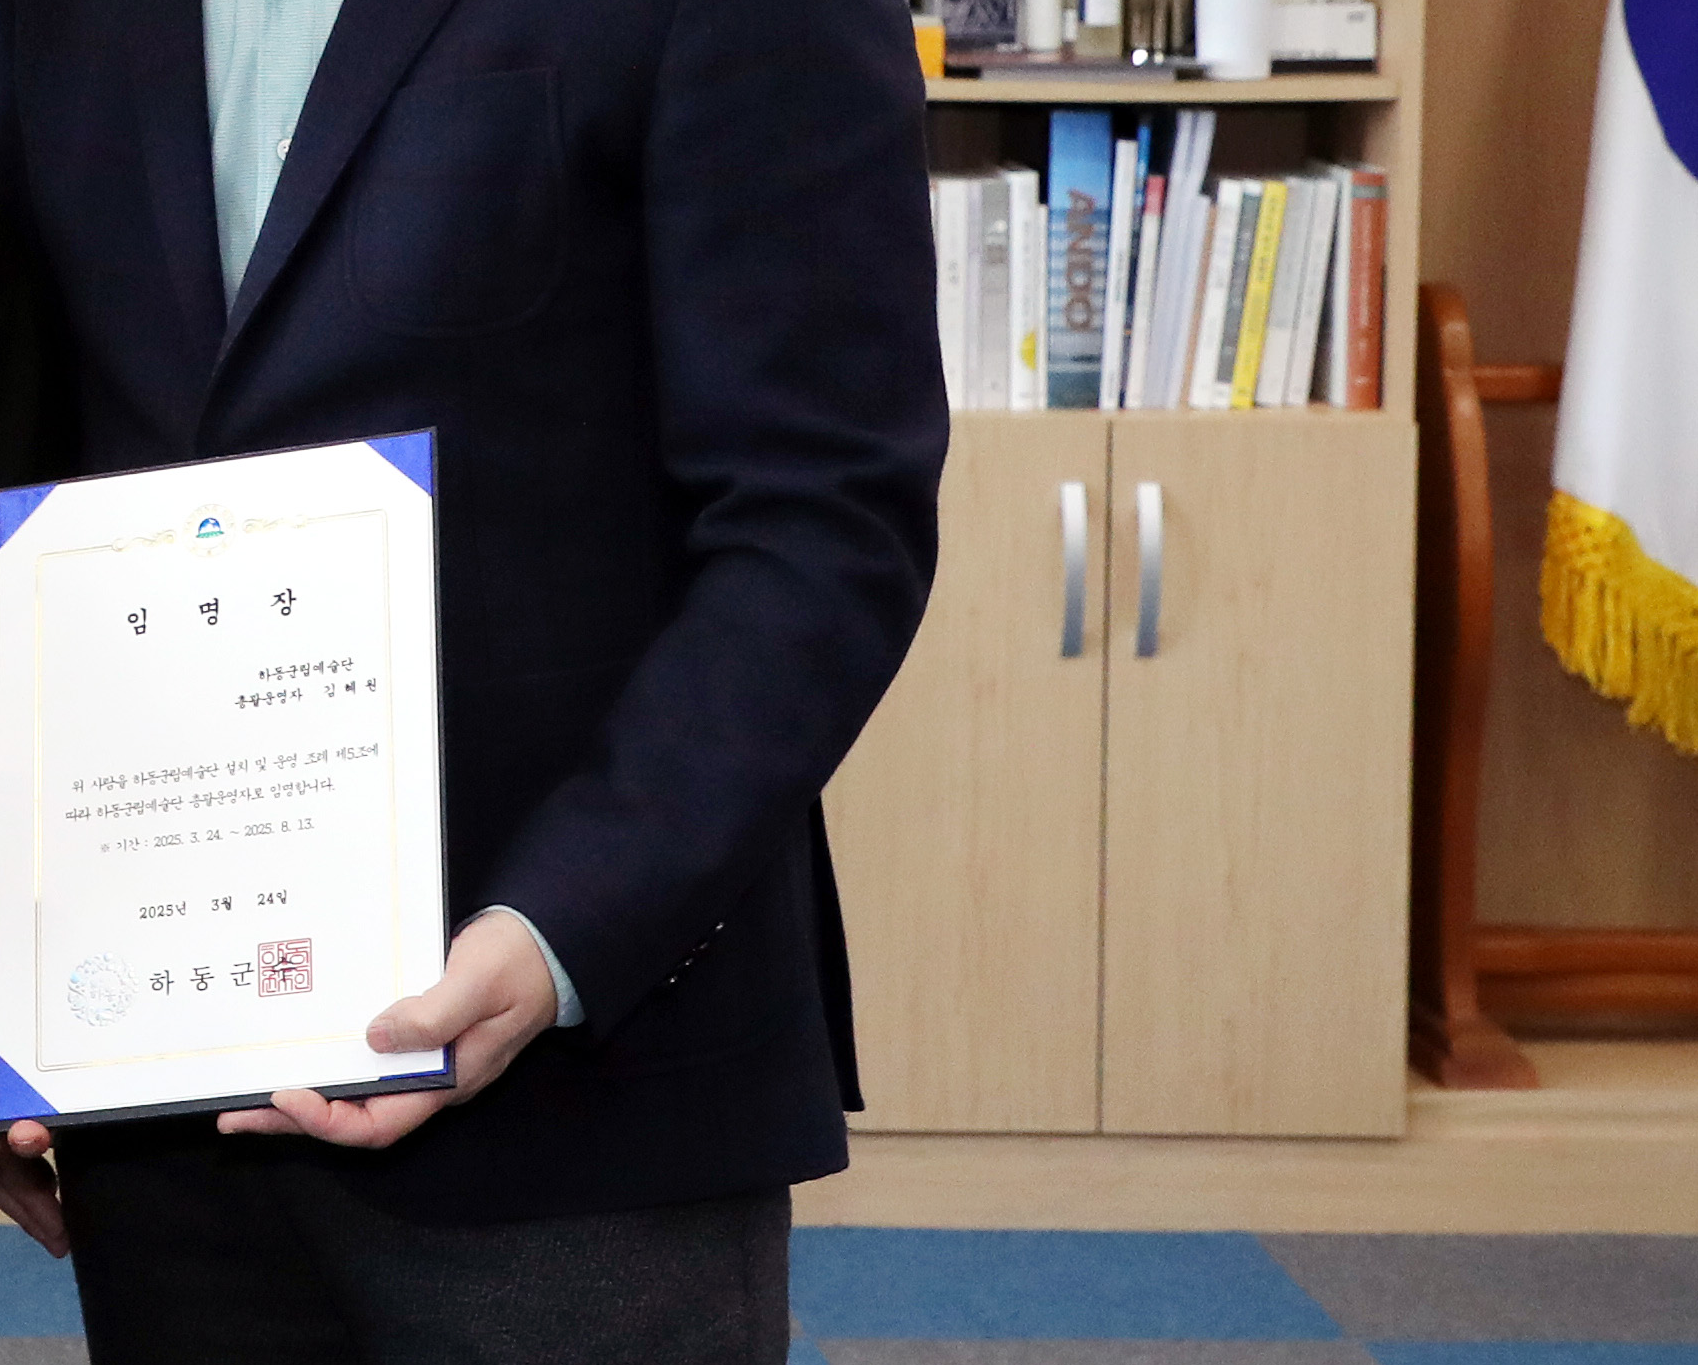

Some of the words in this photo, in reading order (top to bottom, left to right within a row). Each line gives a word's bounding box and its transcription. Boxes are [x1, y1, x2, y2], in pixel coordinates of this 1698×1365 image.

[1064, 189, 1095, 333] ANDO
[259, 657, 354, 682] 하동군립예술단
[235, 687, 303, 709] 총괄운영자
[72, 779, 84, 793] 위
[92, 774, 128, 791] 사람을
[133, 764, 219, 786] 하동군립예술단
[225, 759, 248, 775] 설치
[255, 757, 266, 772] 및
[273, 753, 297, 769] 운영
[304, 749, 328, 765] 조례
[336, 743, 378, 760] 제5조에
[65, 806, 91, 822] 따라
[97, 796, 184, 819] 하동군립예술단
[189, 787, 264, 809] 총괄운영자로
[270, 777, 335, 798] 임명합니다.
[117, 838, 140, 852] 기간
[154, 834, 184, 848] 2025.
[190, 831, 200, 844] 3.
[206, 829, 223, 841] 24.
[244, 823, 275, 837] 2025.
[281, 821, 291, 833] 8.
[297, 818, 315, 831] 13.
[139, 901, 186, 919] 2025년
[211, 896, 232, 911] 3월
[257, 889, 287, 906] 24일
